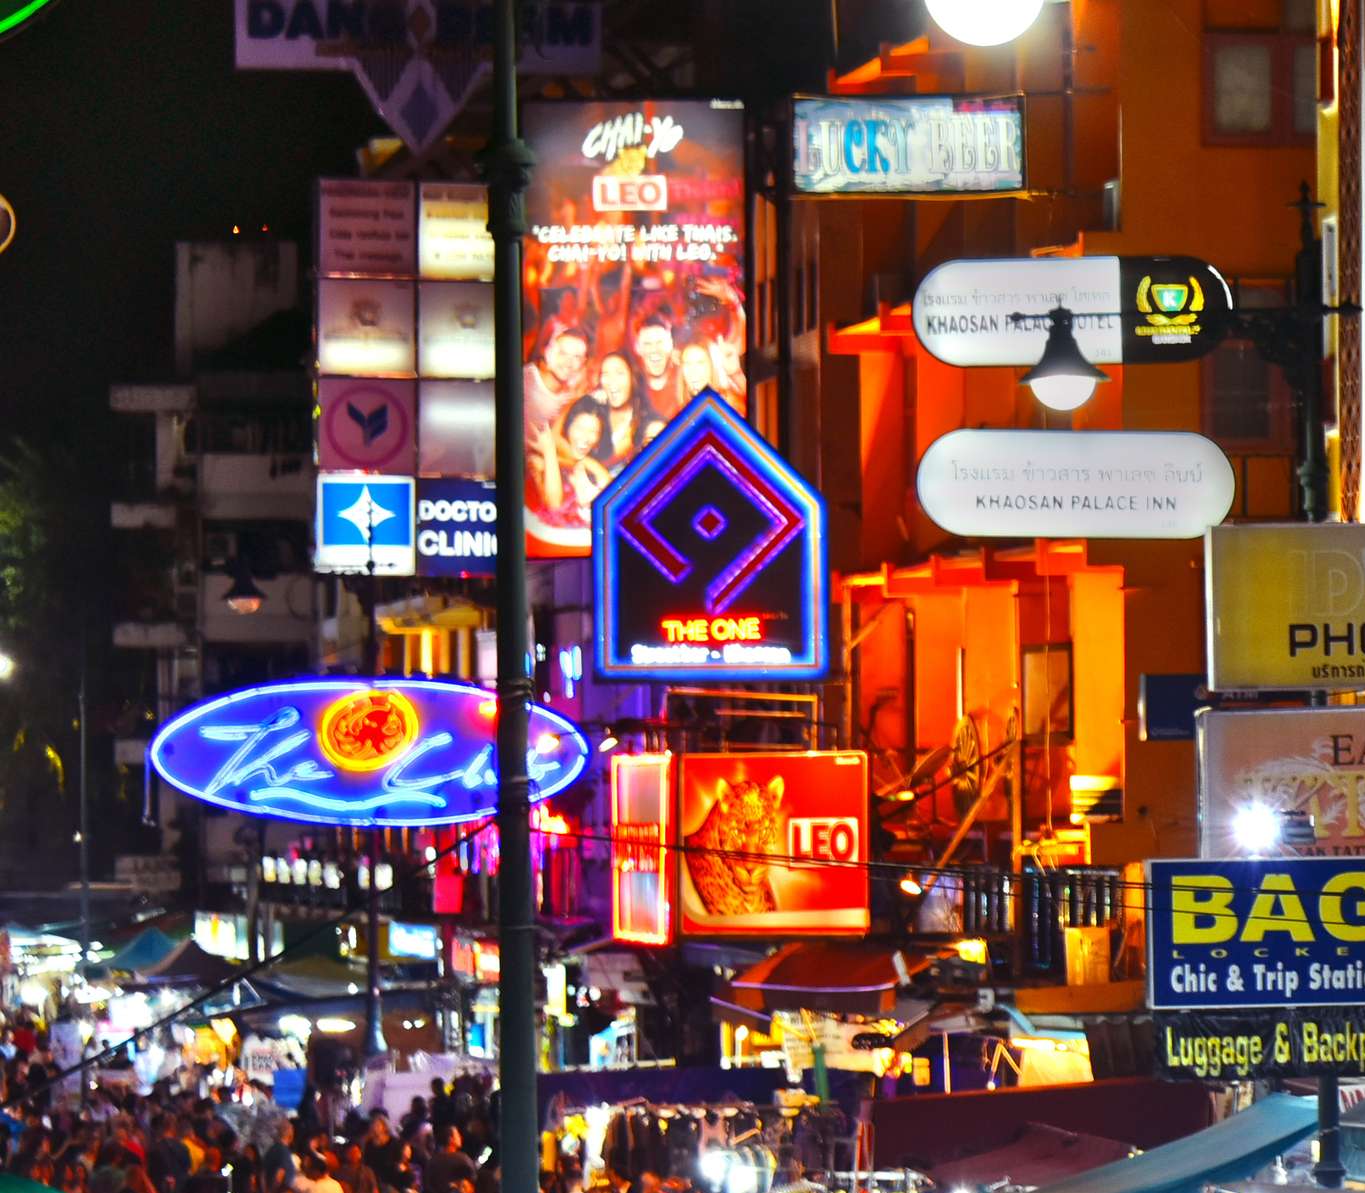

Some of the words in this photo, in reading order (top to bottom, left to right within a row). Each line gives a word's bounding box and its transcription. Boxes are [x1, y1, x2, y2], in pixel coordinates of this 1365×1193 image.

[929, 118, 1022, 176] BEER
[599, 181, 660, 205] LEO
[926, 313, 998, 337] KHAOSAN
[419, 501, 498, 521] DOCTO
[976, 494, 1063, 511] KHAOSAN
[1071, 495, 1138, 511] PALACE
[1146, 495, 1177, 511] INN
[419, 530, 498, 557] CLINI
[661, 620, 709, 641] THE
[710, 618, 762, 641] ONE
[792, 820, 856, 861] LEO
[1171, 965, 1218, 993] Chic
[1225, 964, 1246, 991] &
[1253, 961, 1300, 998] Trip
[1166, 1024, 1264, 1078] Luggage
[1273, 1022, 1291, 1065] &
